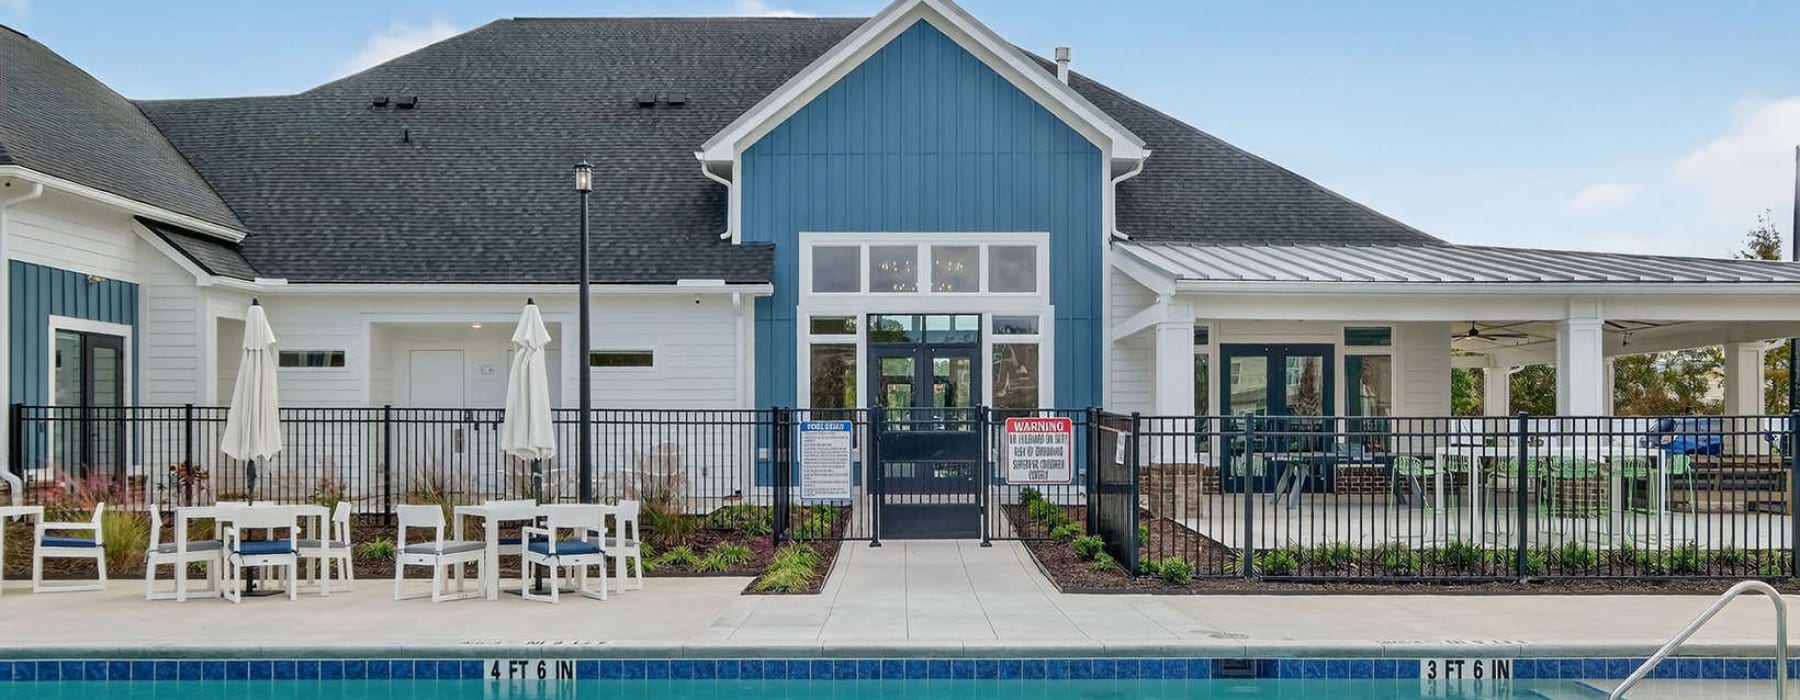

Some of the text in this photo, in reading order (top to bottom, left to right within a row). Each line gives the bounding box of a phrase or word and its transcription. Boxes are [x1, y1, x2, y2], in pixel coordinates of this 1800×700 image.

[1014, 421, 1064, 432] WARNING
[491, 660, 573, 679] 4 FT 6 IN
[1428, 660, 1509, 679] 3 FT 6 IN
